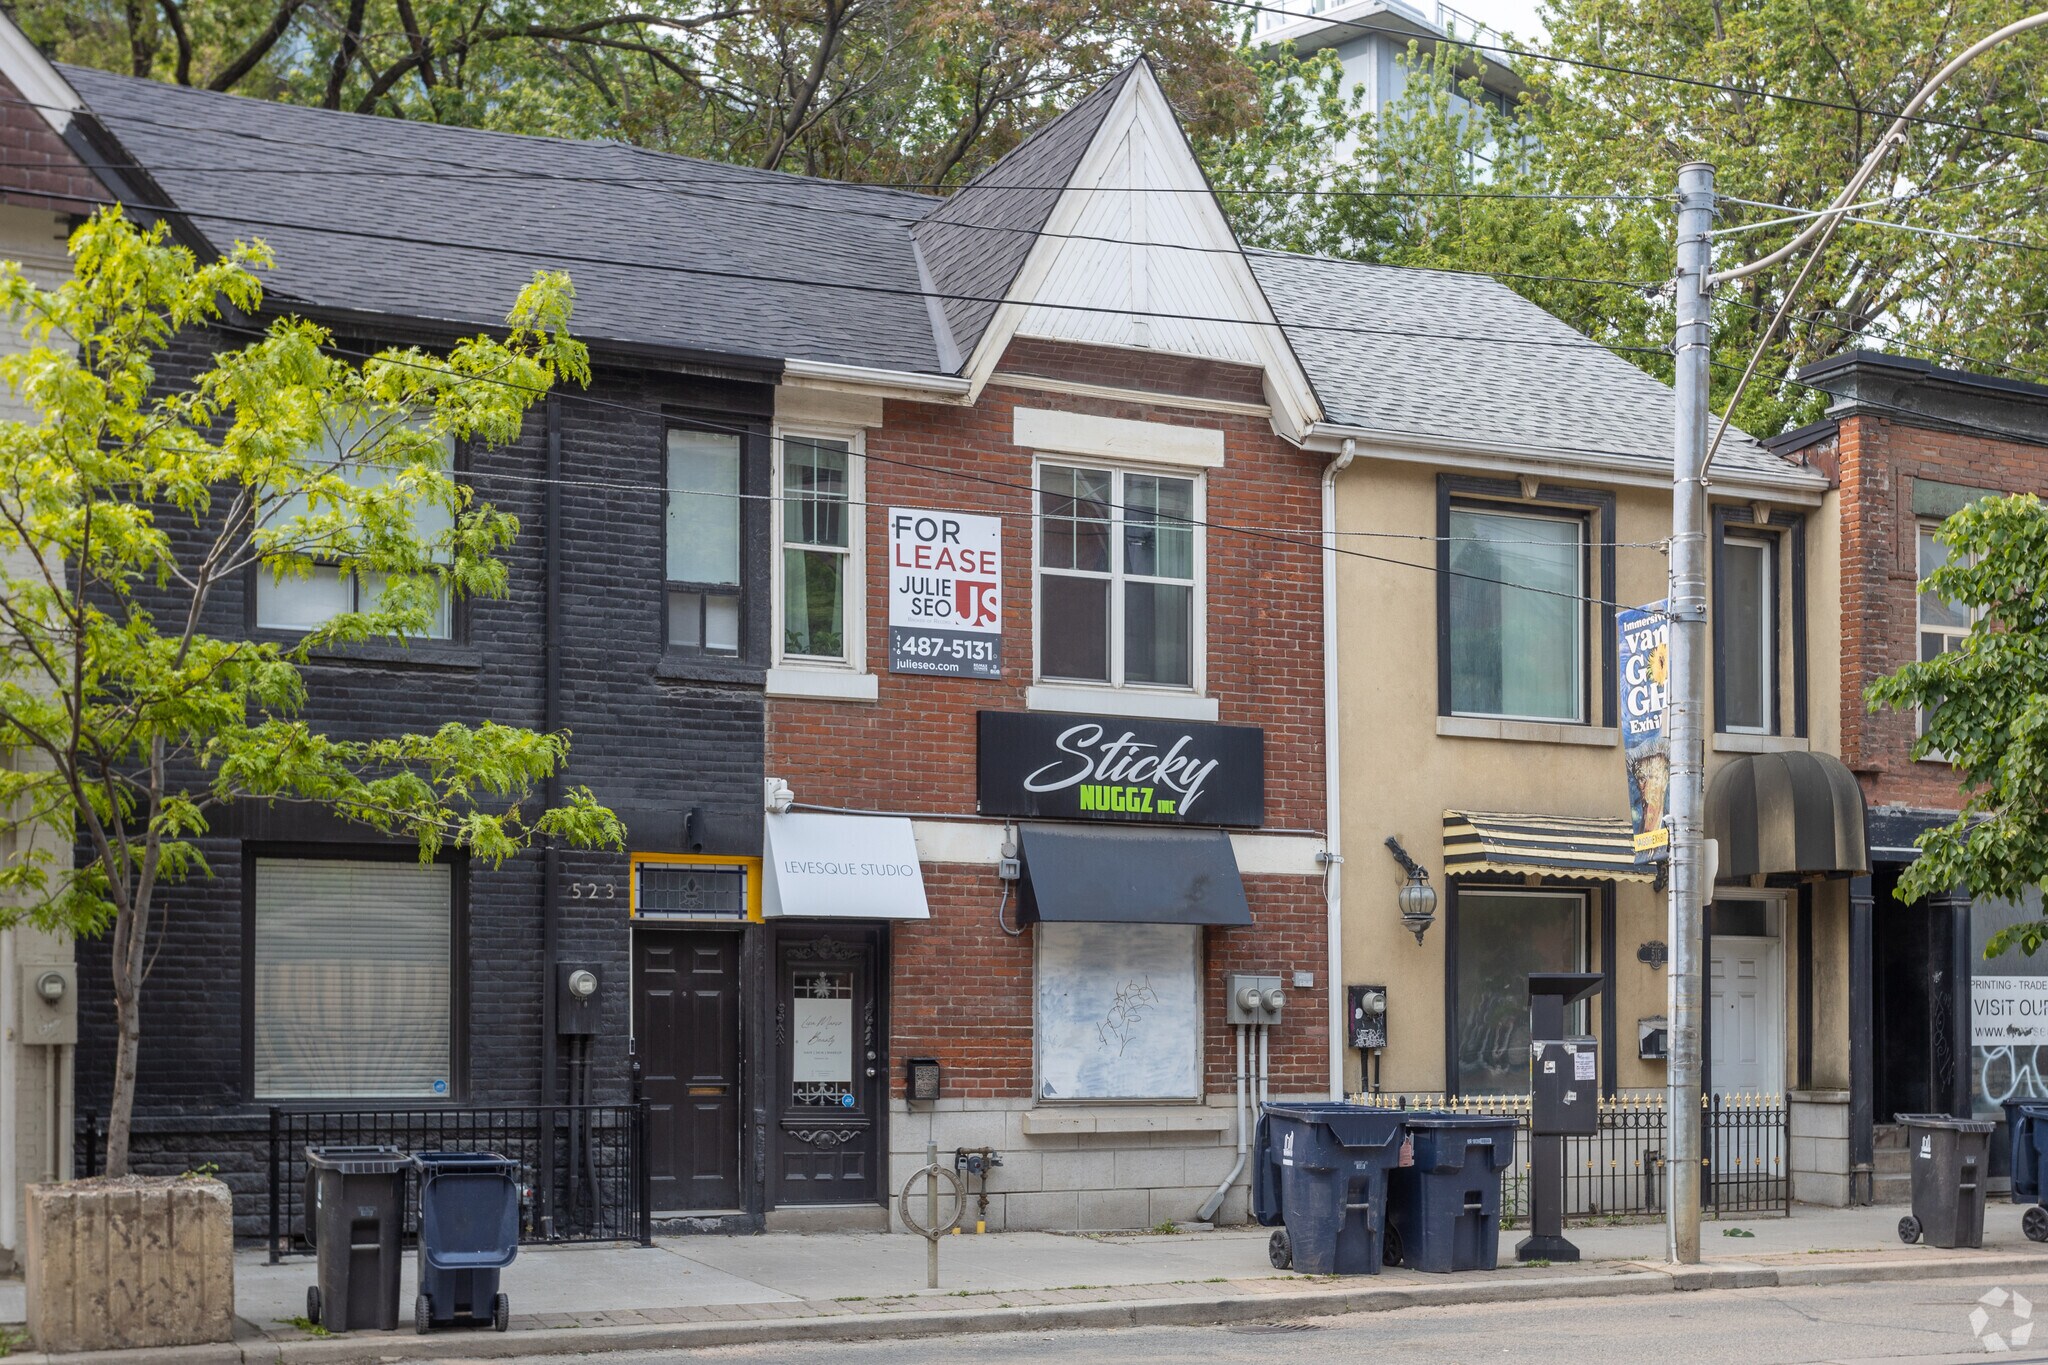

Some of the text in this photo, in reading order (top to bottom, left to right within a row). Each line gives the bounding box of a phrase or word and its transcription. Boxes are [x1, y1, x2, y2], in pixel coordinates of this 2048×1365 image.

[895, 515, 961, 545] FOR
[895, 543, 997, 575] LEASE
[899, 576, 952, 597] JULIE
[911, 597, 952, 617] SEO
[902, 636, 993, 661] 487-5131
[1625, 624, 1668, 654] van
[896, 658, 959, 672] julieseo.com
[1627, 681, 1668, 717] GH
[1630, 714, 1662, 734] Exhi
[1023, 723, 1219, 816] Sticky
[1080, 784, 1176, 814] NUGGZ INC
[784, 861, 913, 877] LEVESQUE STUDIO
[572, 882, 614, 899] 523
[1971, 980, 2011, 990] PRINTING
[2019, 980, 2047, 990] TRADE
[1974, 999, 2015, 1016] VISIT
